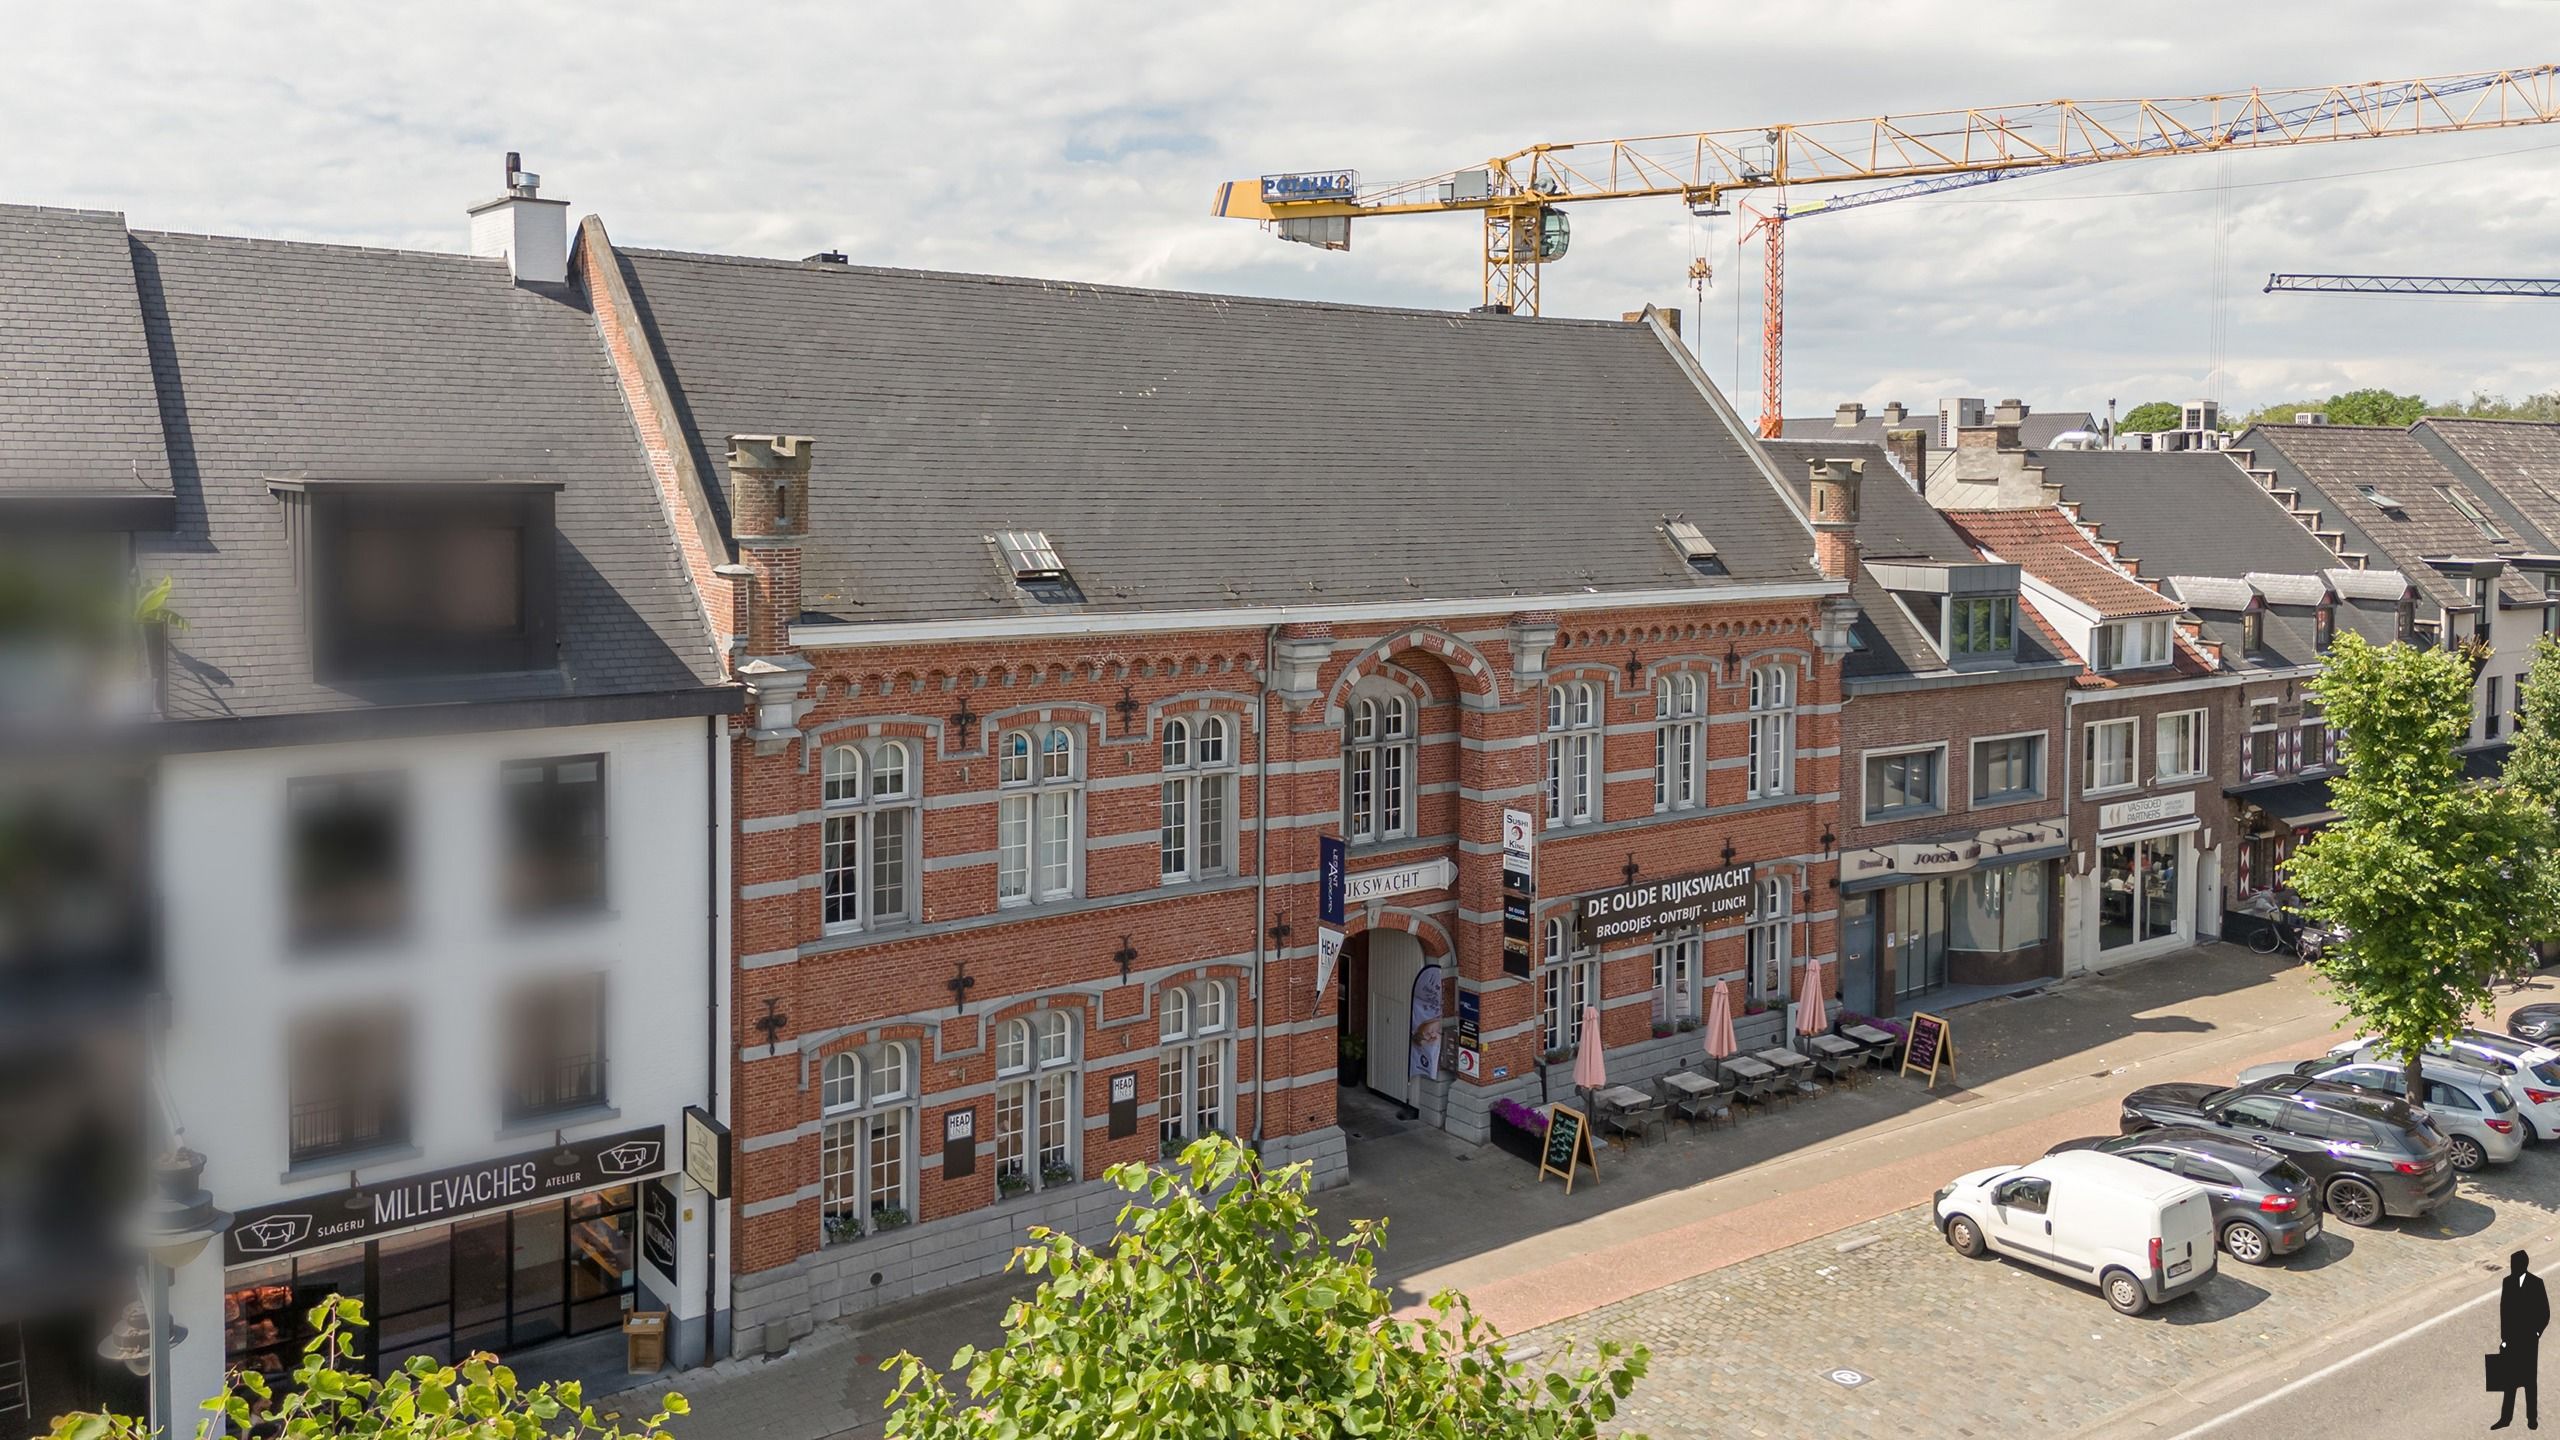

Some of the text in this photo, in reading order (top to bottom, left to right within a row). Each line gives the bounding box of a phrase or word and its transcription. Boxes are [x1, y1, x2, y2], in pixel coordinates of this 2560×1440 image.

[2127, 799, 2161, 812] VASTGOED
[2127, 809, 2161, 823] PARTNERS
[1343, 872, 1419, 898] IJKSWACHT
[1588, 867, 1751, 918] DE OUDE RIJKSWACHT
[1596, 916, 1651, 938] BROODJES
[1659, 905, 1702, 925] ONTBIJT
[1711, 896, 1746, 913] LUNCH
[1114, 1077, 1133, 1090] HEAD
[950, 1114, 970, 1128] HEAD
[317, 1161, 582, 1237] SLAGERIJ MILLEVACHES ATELIER
